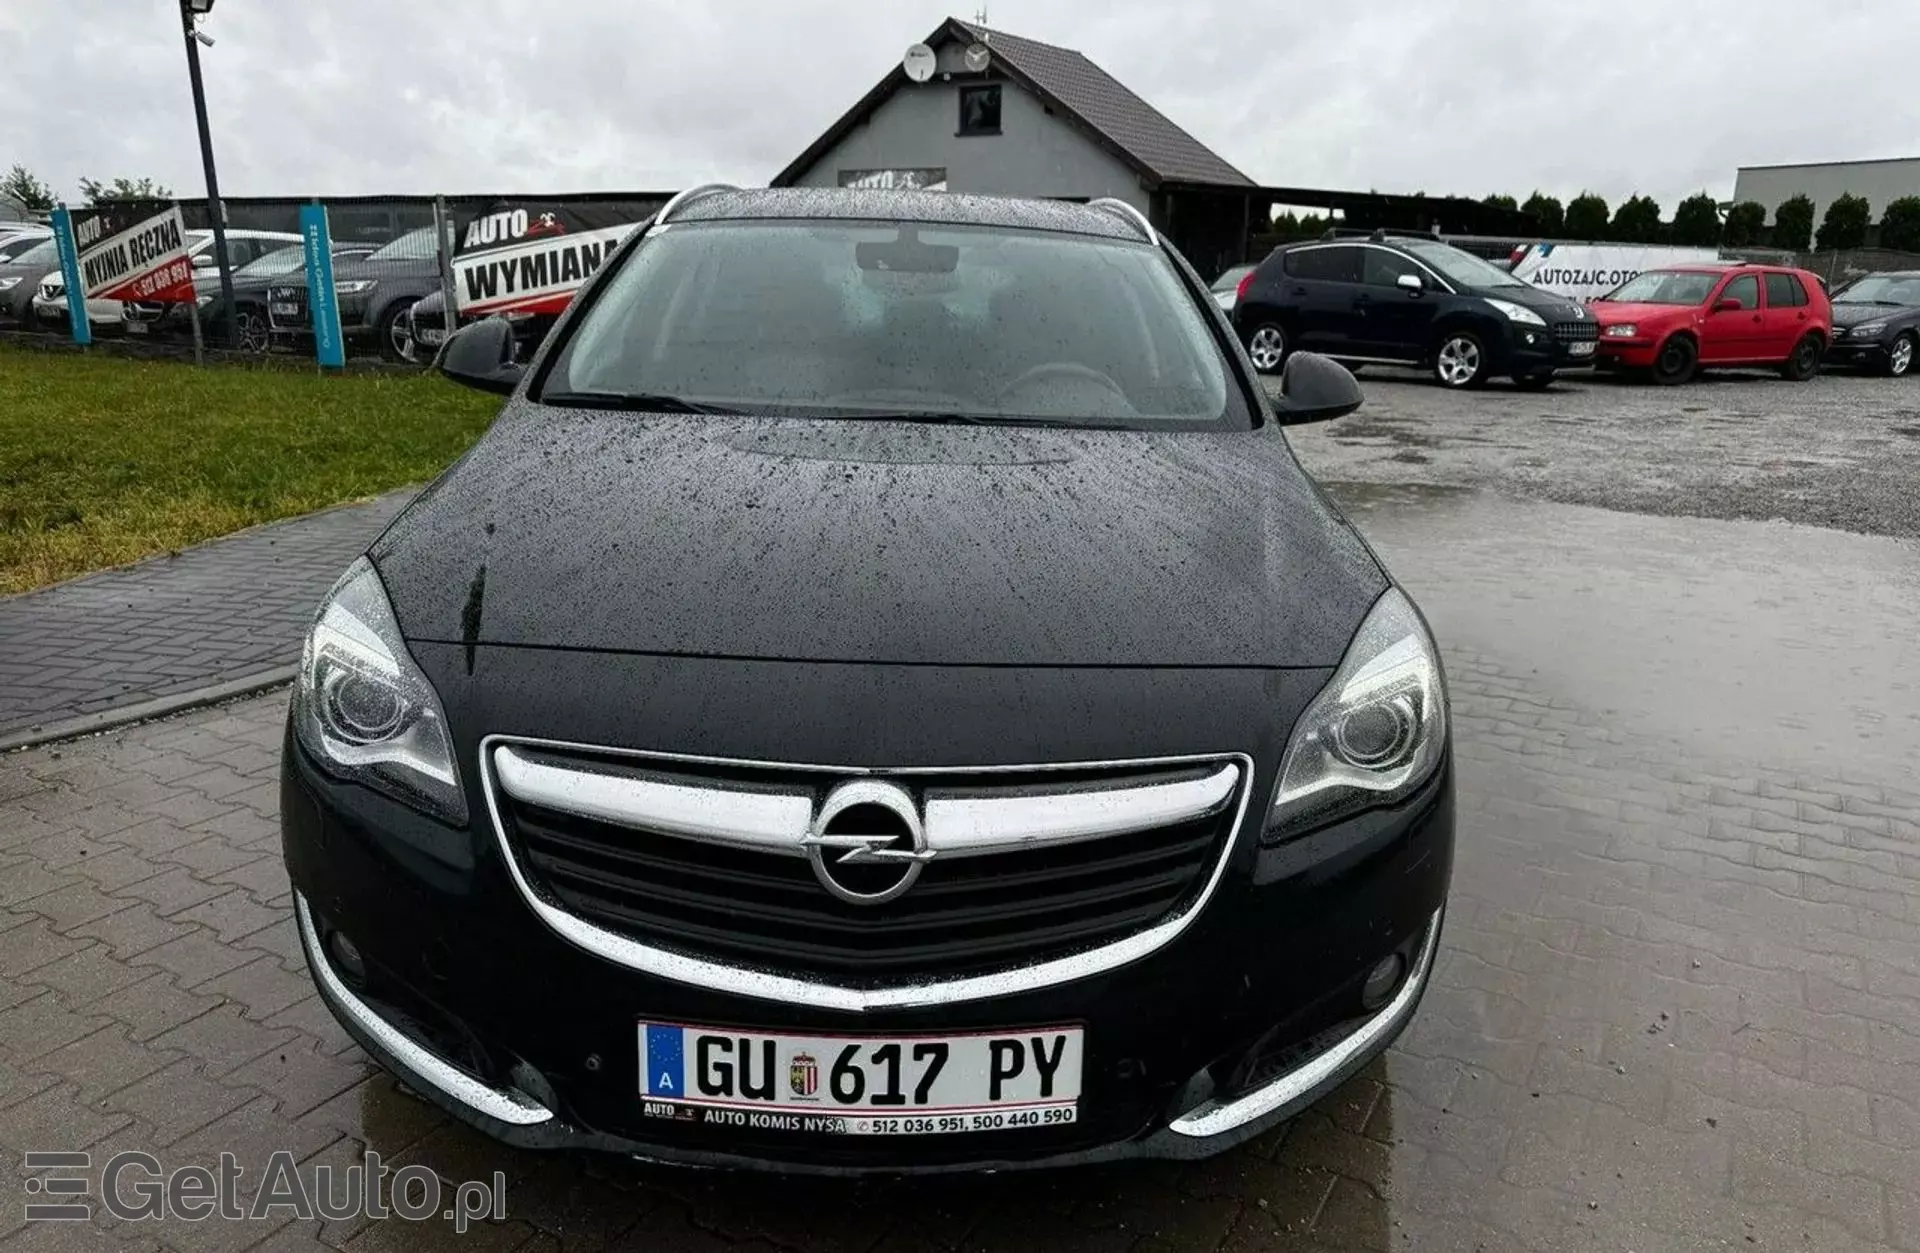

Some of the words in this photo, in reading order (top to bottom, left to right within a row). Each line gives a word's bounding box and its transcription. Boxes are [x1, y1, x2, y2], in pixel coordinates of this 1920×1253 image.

[78, 215, 100, 247] AUTO
[464, 209, 528, 248] AUTO
[84, 244, 129, 288] MYJNIA
[129, 217, 182, 268] RĘCZNA
[658, 1073, 673, 1089] A
[696, 1035, 776, 1097] GU
[829, 1043, 950, 1105] 617
[988, 1035, 1067, 1101] PY
[644, 1102, 675, 1116] AUTO
[704, 1109, 745, 1126] AUTO
[750, 1114, 801, 1130] KOMIS
[872, 1120, 898, 1133] 512
[904, 1119, 934, 1132] 036
[973, 1115, 1003, 1129] 500
[1008, 1111, 1039, 1126] 440
[1043, 1108, 1073, 1123] 590
